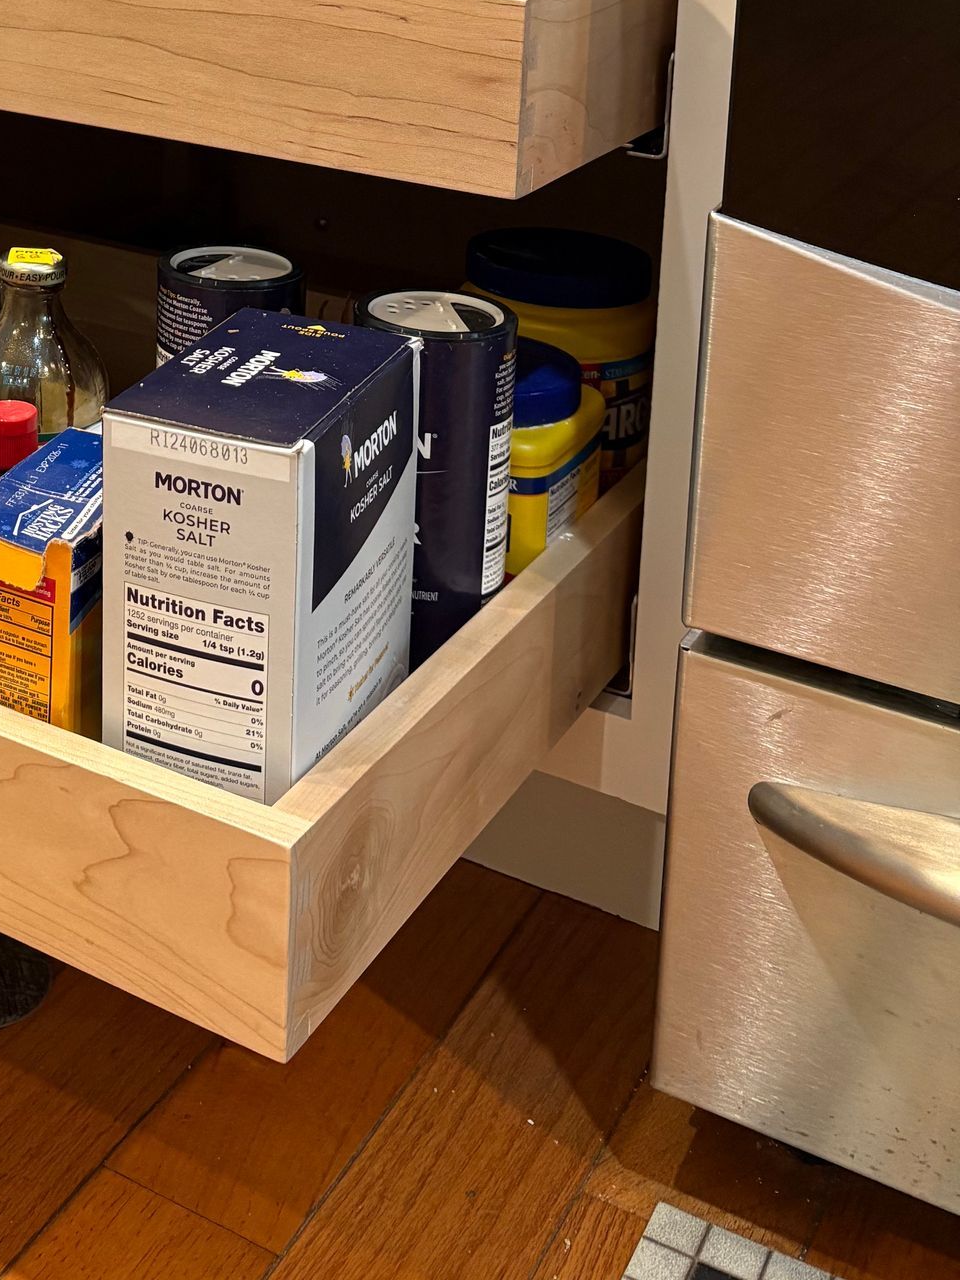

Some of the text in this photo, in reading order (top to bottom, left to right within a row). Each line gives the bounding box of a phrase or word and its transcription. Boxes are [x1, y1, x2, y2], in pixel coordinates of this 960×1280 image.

[20, 269, 65, 282] EASY POUR
[181, 348, 211, 366] SALT
[192, 346, 236, 375] KOSHER
[221, 349, 281, 388] MORTON
[150, 428, 248, 465] RI24068013
[353, 410, 398, 479] MORTON
[155, 471, 242, 506] MORTON
[350, 465, 393, 524] KOSHER SALT
[21, 504, 65, 537] HOSTING
[179, 501, 213, 515] COARSE
[33, 508, 74, 541] HACKS
[163, 508, 231, 535] KOSHER
[176, 528, 216, 548] SALT
[124, 543, 136, 552] Salt
[149, 550, 162, 559] you
[164, 553, 185, 565] would
[187, 558, 204, 569] table
[224, 567, 236, 575] For
[238, 570, 271, 582] amounts
[138, 538, 149, 547] TIP:
[150, 541, 180, 555] Generally,
[180, 549, 192, 558] you
[193, 552, 205, 561] can
[206, 555, 218, 563] use
[247, 563, 271, 574] Kosher
[124, 552, 147, 564] greater
[148, 558, 164, 568] than
[190, 567, 219, 581] increase
[220, 574, 232, 583] the
[233, 578, 261, 590] amount
[263, 583, 271, 591] of
[124, 560, 270, 600] Kosher Salt by one tablespoon for each cup
[131, 570, 147, 581] table
[30, 615, 50, 627] Purpose
[126, 586, 265, 634] Nutrition Facts
[126, 619, 180, 641] Serving size
[127, 608, 234, 643] 1252 servings per container
[126, 642, 196, 668] Amount per serving
[202, 639, 265, 662] 1/4 tsp (1.2g)
[126, 652, 184, 679] Calories
[127, 685, 167, 704] Total Fat 0g
[251, 679, 264, 696] 0
[127, 696, 176, 719] Sodium 480mg
[222, 699, 240, 710] Daily
[126, 720, 161, 739] Protein 0g
[127, 708, 203, 739] Total Carbohydrate 0g
[245, 728, 264, 739] 21%
[251, 717, 264, 726] 0%
[250, 742, 263, 751] 0%
